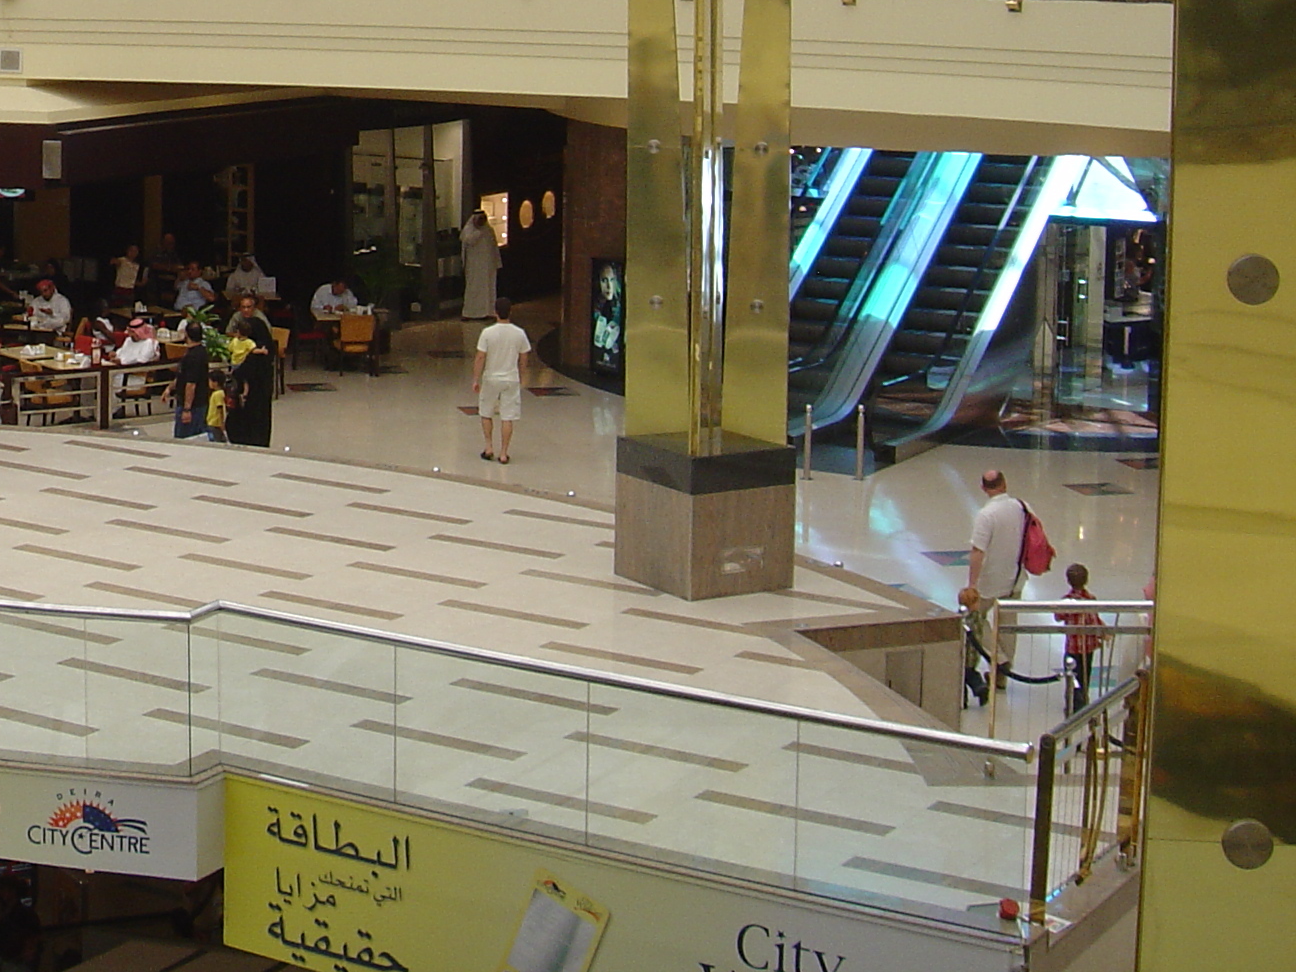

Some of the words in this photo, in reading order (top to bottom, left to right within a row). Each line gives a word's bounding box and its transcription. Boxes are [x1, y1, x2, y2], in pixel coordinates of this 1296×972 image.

[56, 787, 115, 807] DEIRA
[266, 805, 410, 879] البطاقة
[275, 866, 337, 912] مزايا
[372, 886, 403, 907] التي
[266, 901, 410, 972] حقيقية
